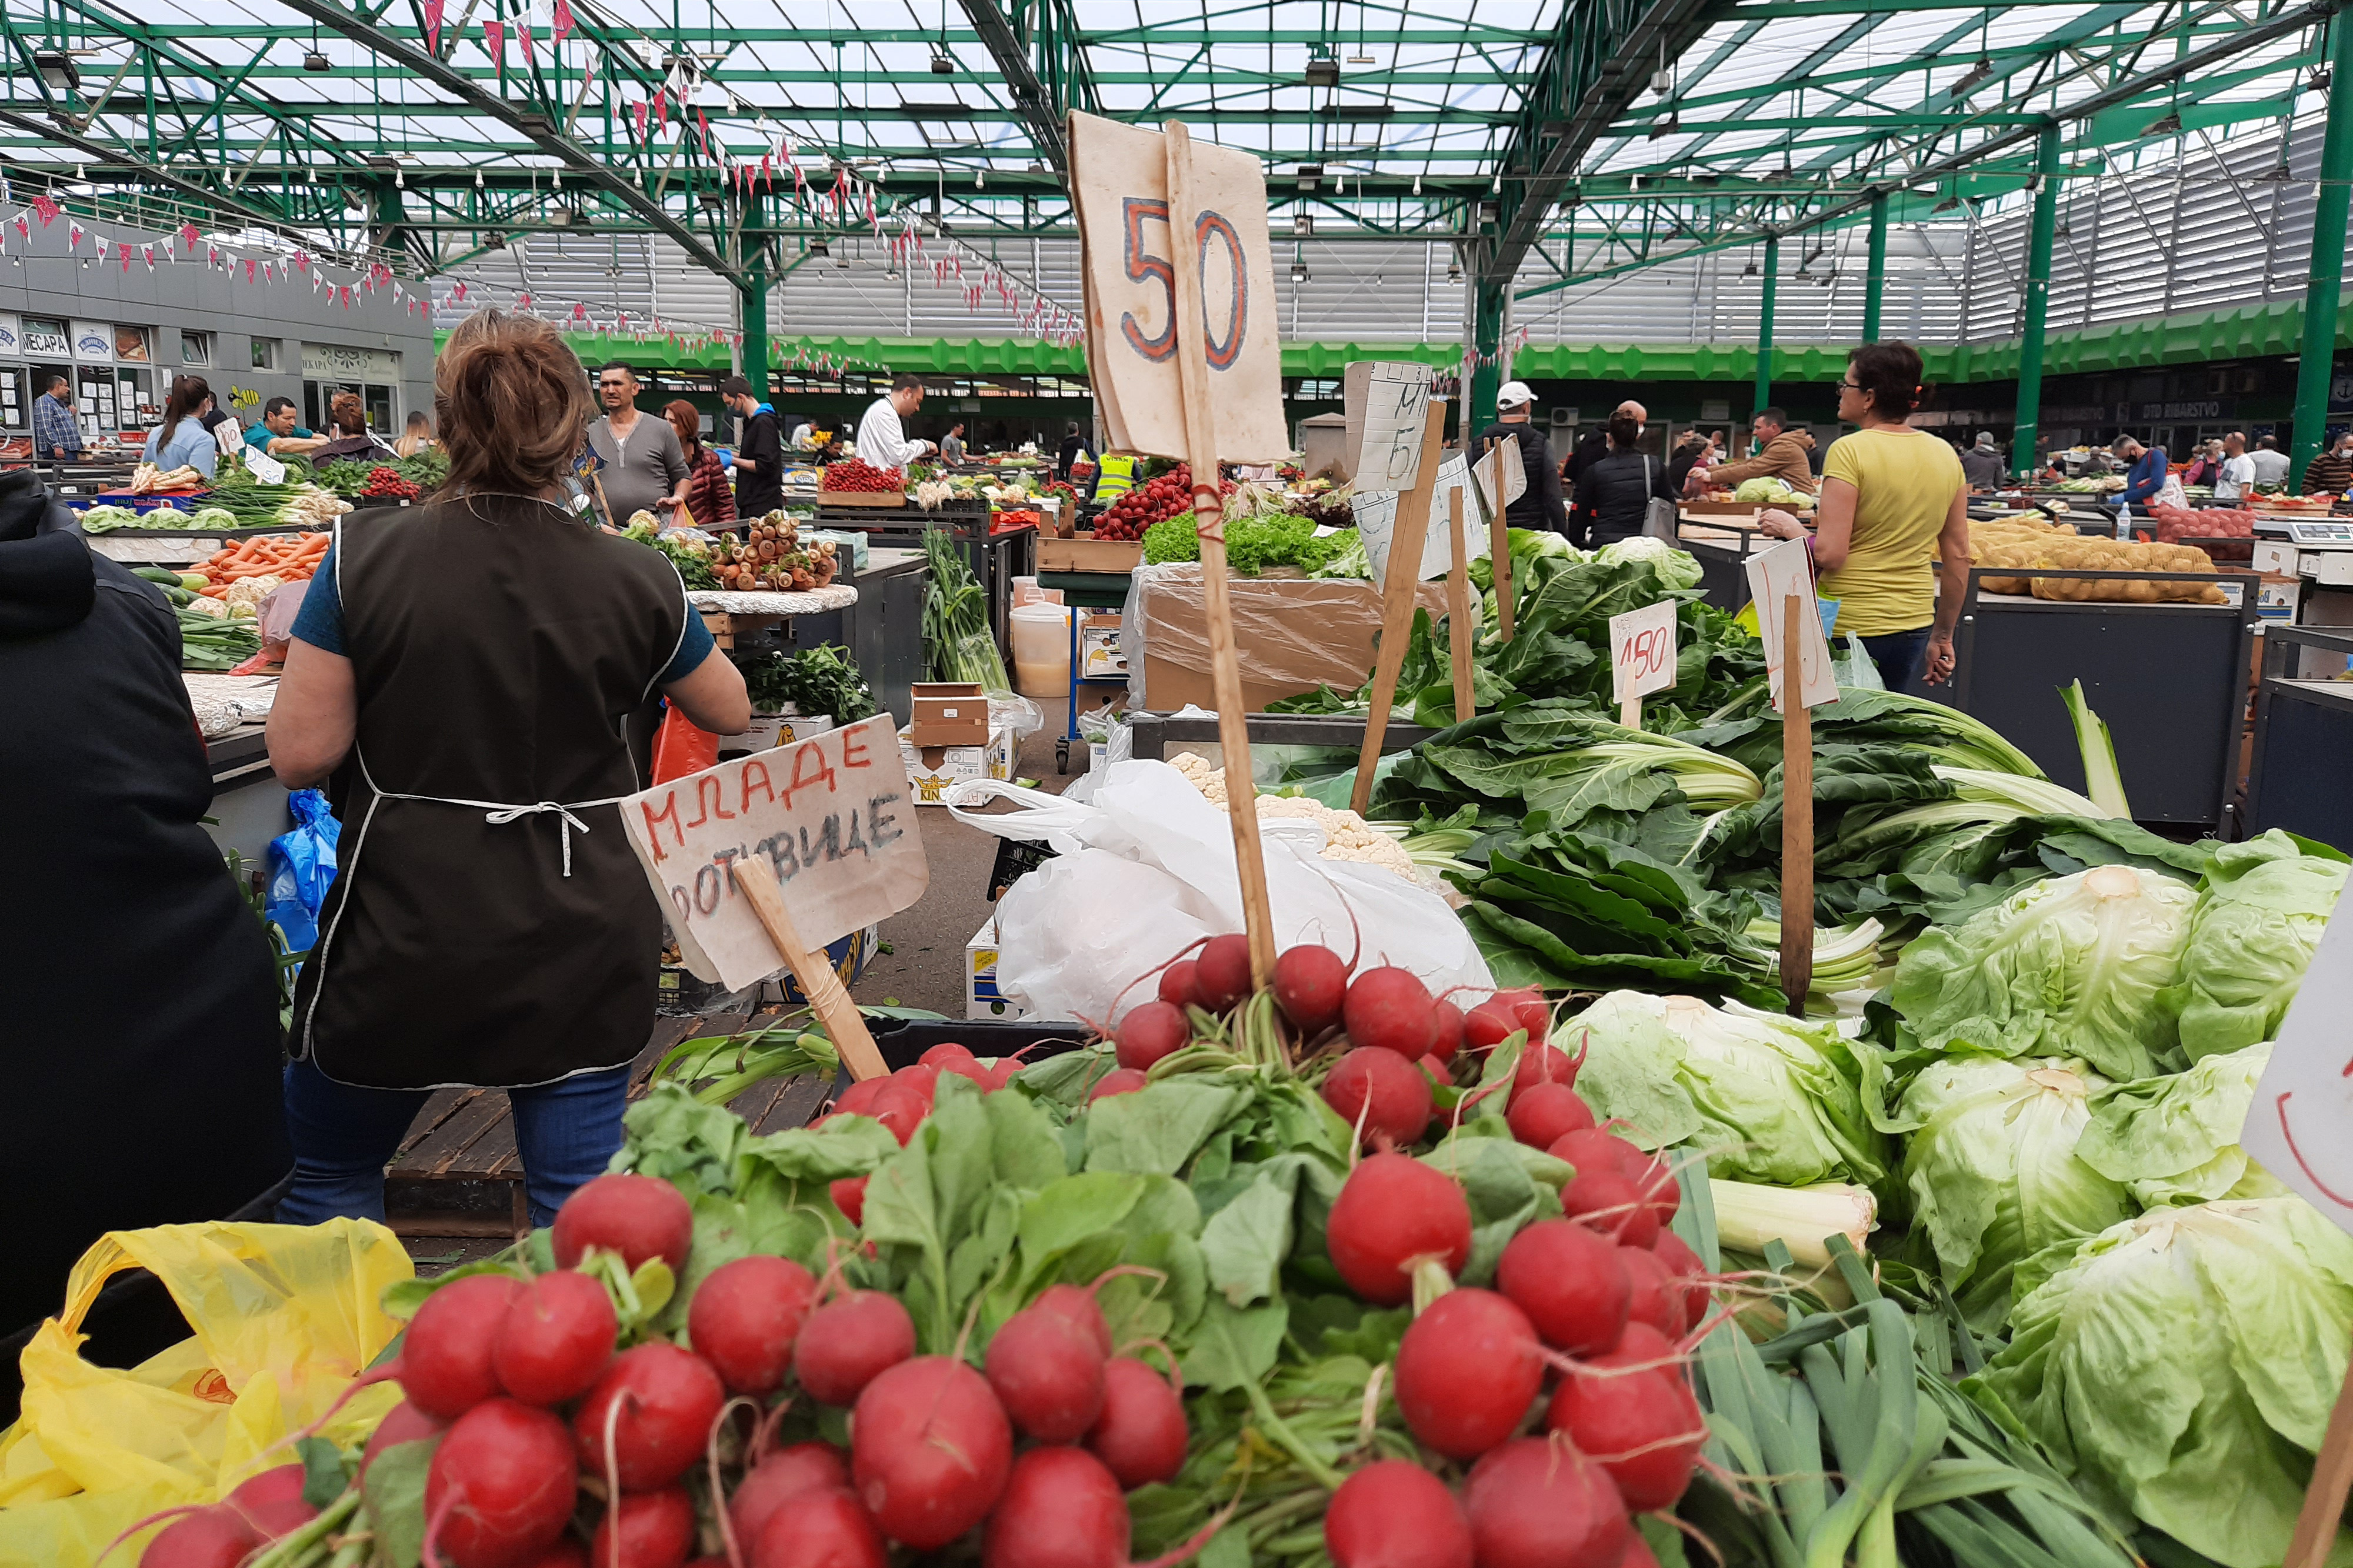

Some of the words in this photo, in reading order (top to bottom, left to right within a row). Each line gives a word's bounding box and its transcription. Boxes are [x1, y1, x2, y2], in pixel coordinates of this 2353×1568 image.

[23, 333, 68, 353] МЕСАРА
[1121, 196, 1249, 372] 50
[640, 725, 871, 866] МЛАДЕ
[671, 794, 903, 922] РОТВИЦЕ
[920, 789, 944, 802] KIN
